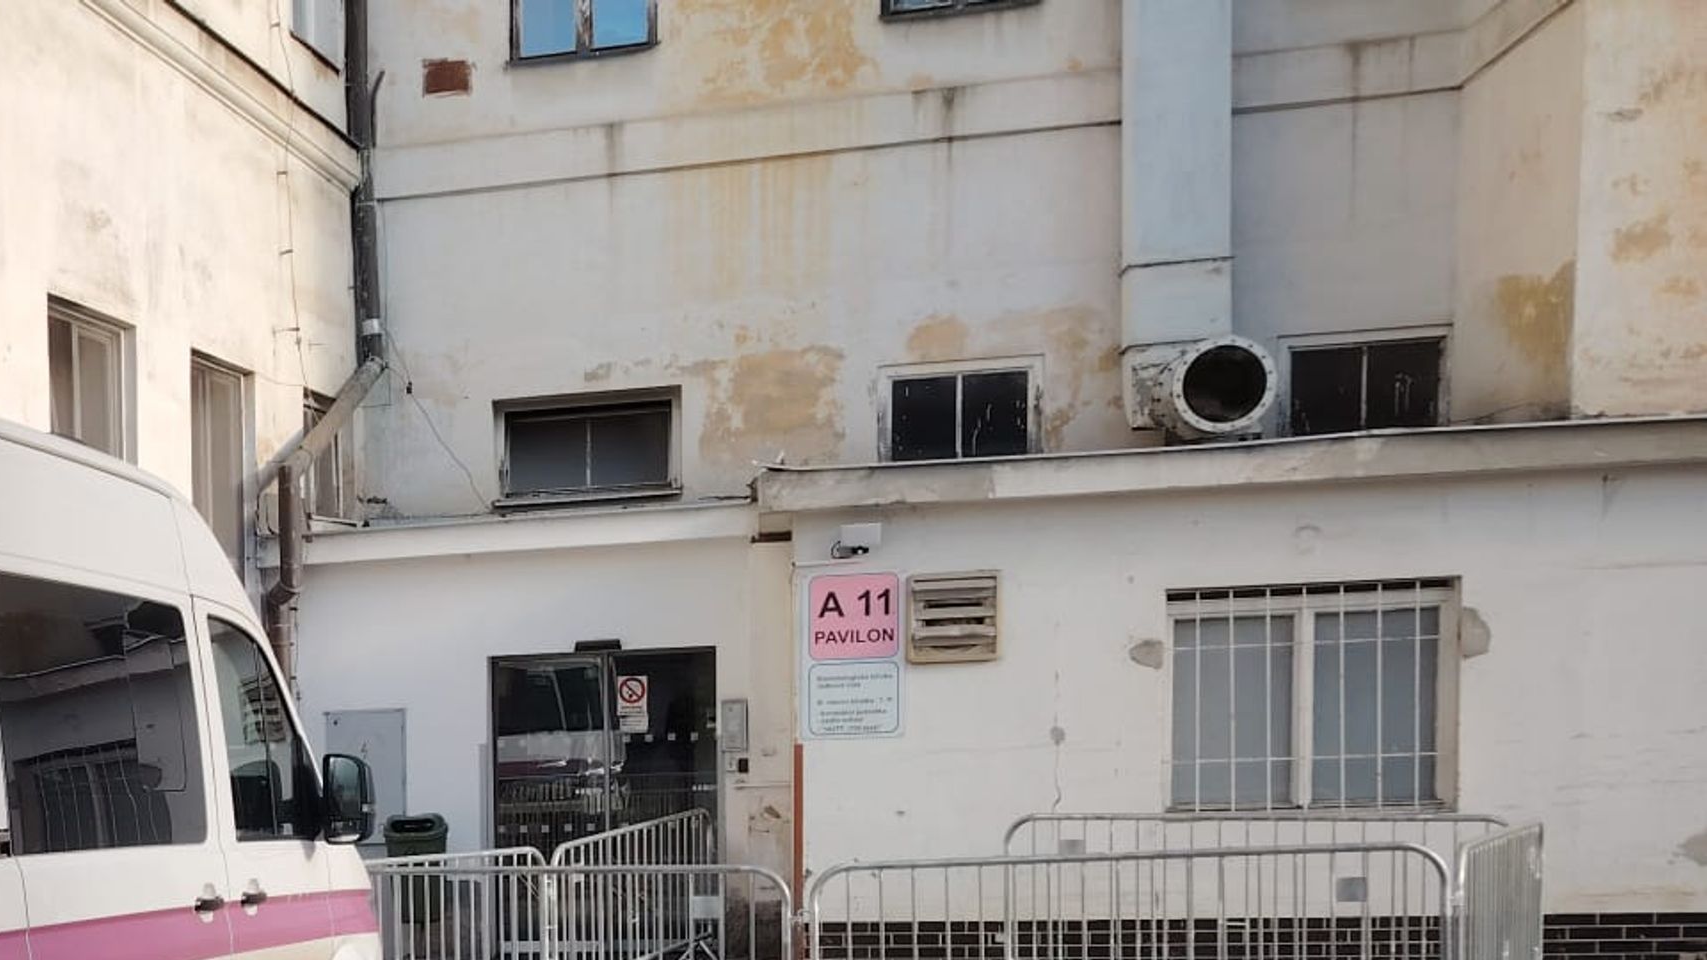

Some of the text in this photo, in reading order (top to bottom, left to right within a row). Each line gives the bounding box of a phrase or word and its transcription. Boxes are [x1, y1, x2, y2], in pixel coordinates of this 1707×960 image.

[818, 588, 892, 618] A 11
[814, 628, 895, 645] PAVILON
